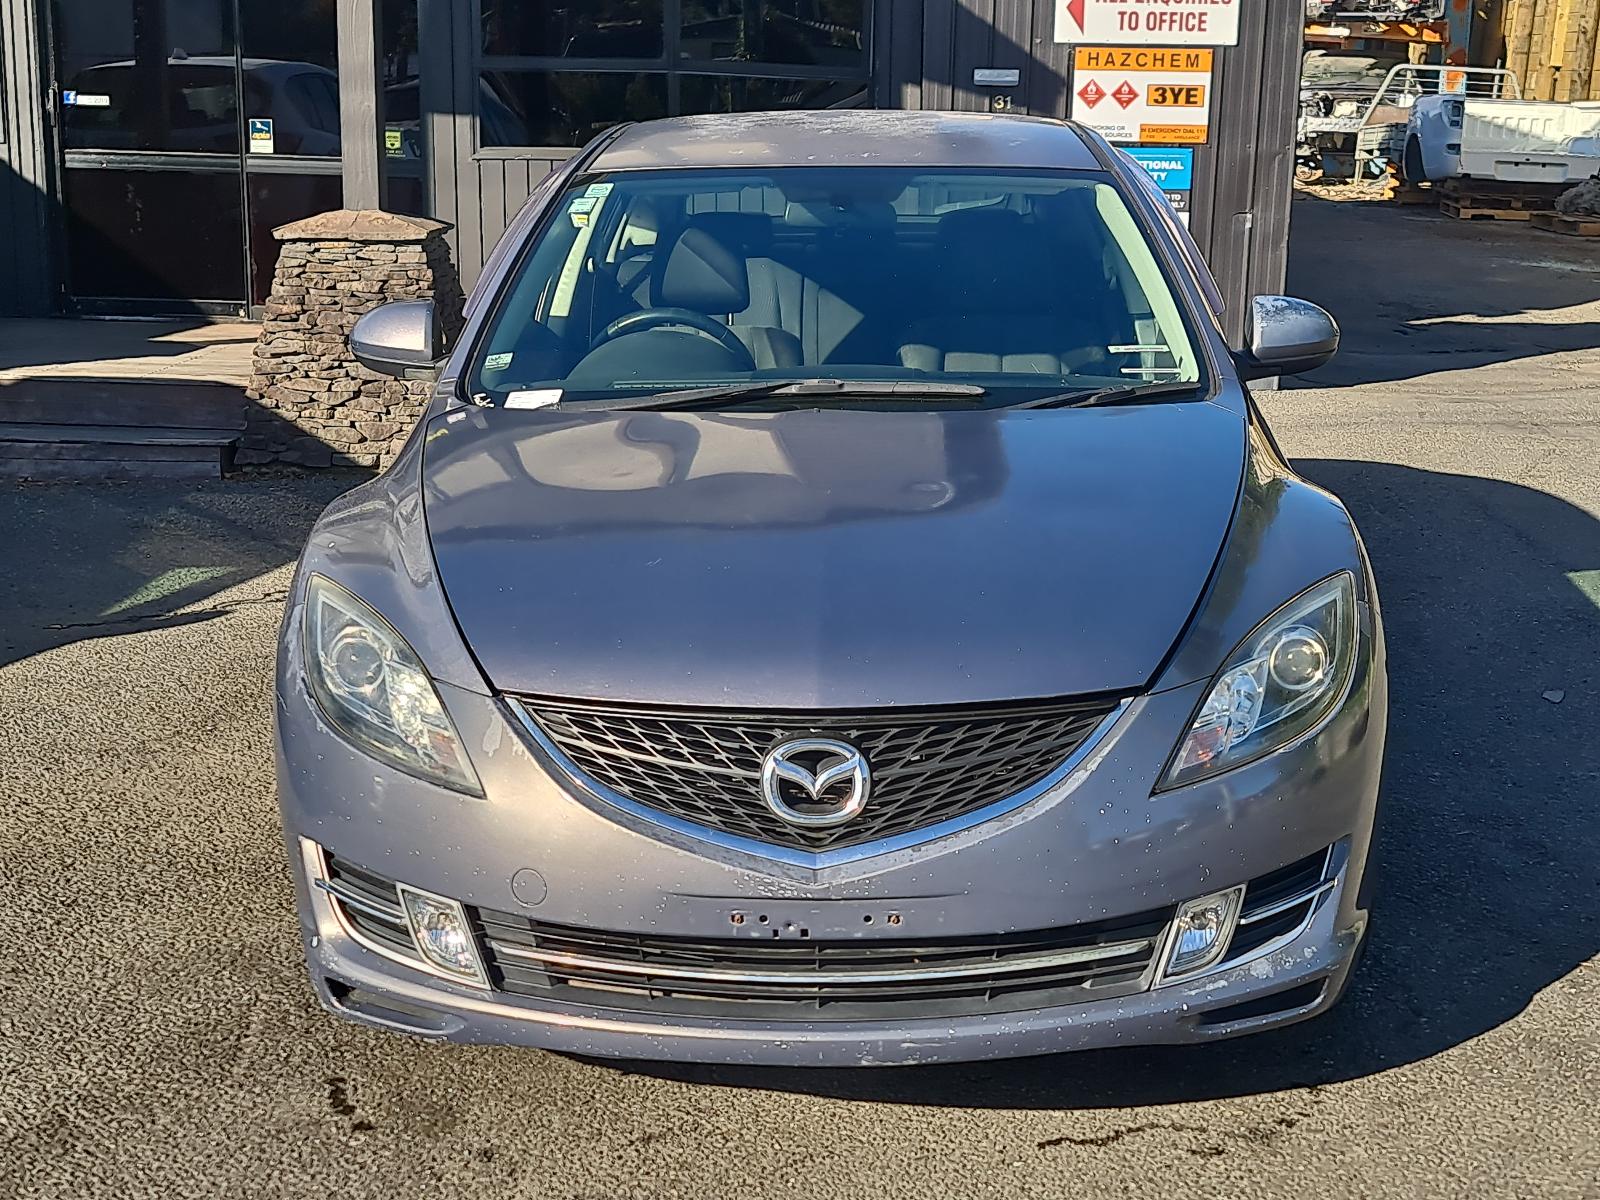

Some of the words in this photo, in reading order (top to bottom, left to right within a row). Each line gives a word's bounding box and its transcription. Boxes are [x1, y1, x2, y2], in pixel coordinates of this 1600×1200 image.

[1118, 11, 1139, 31] TO
[1146, 11, 1208, 32] OFFICE
[1087, 51, 1200, 68] HAZCHEM
[994, 95, 1012, 109] 31
[1153, 86, 1199, 105] 3YE
[1142, 160, 1185, 170] TIONAL
[1171, 193, 1182, 201] TO
